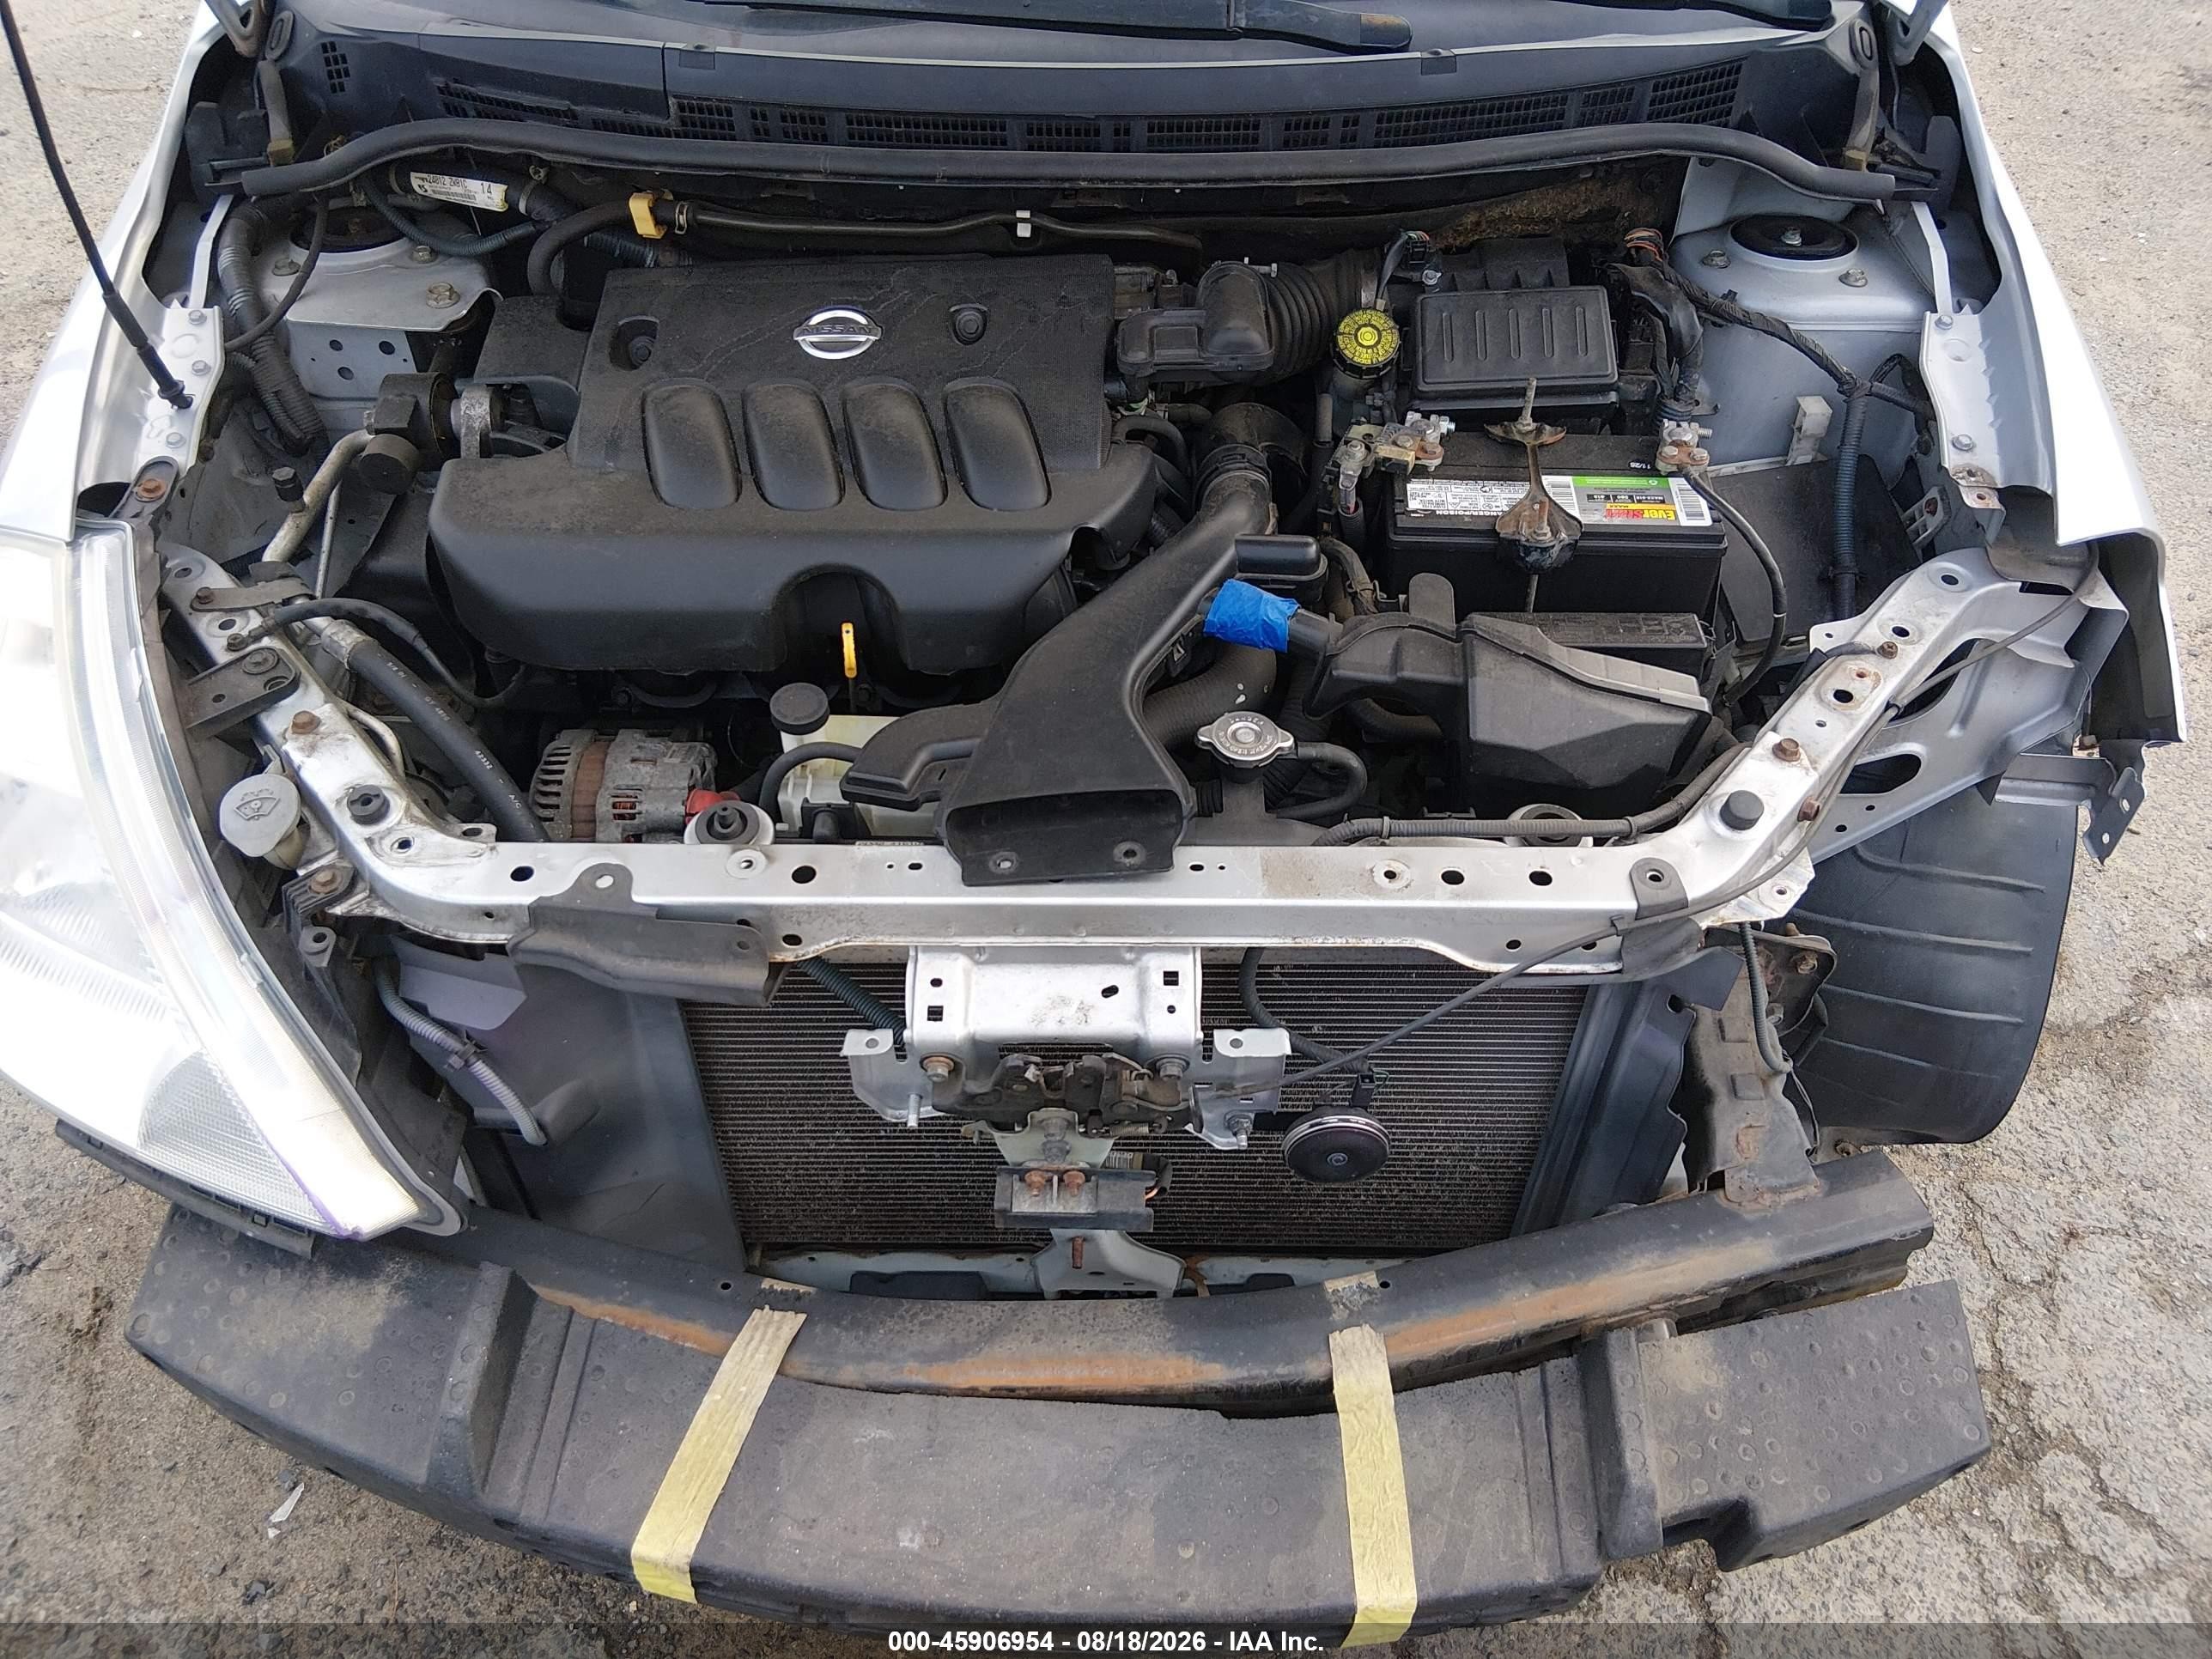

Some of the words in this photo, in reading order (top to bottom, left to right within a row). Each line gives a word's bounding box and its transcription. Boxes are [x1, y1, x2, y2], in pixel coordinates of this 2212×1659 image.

[480, 181, 493, 194] 14
[803, 325, 872, 334] NISSAN
[508, 794, 522, 809] A/C
